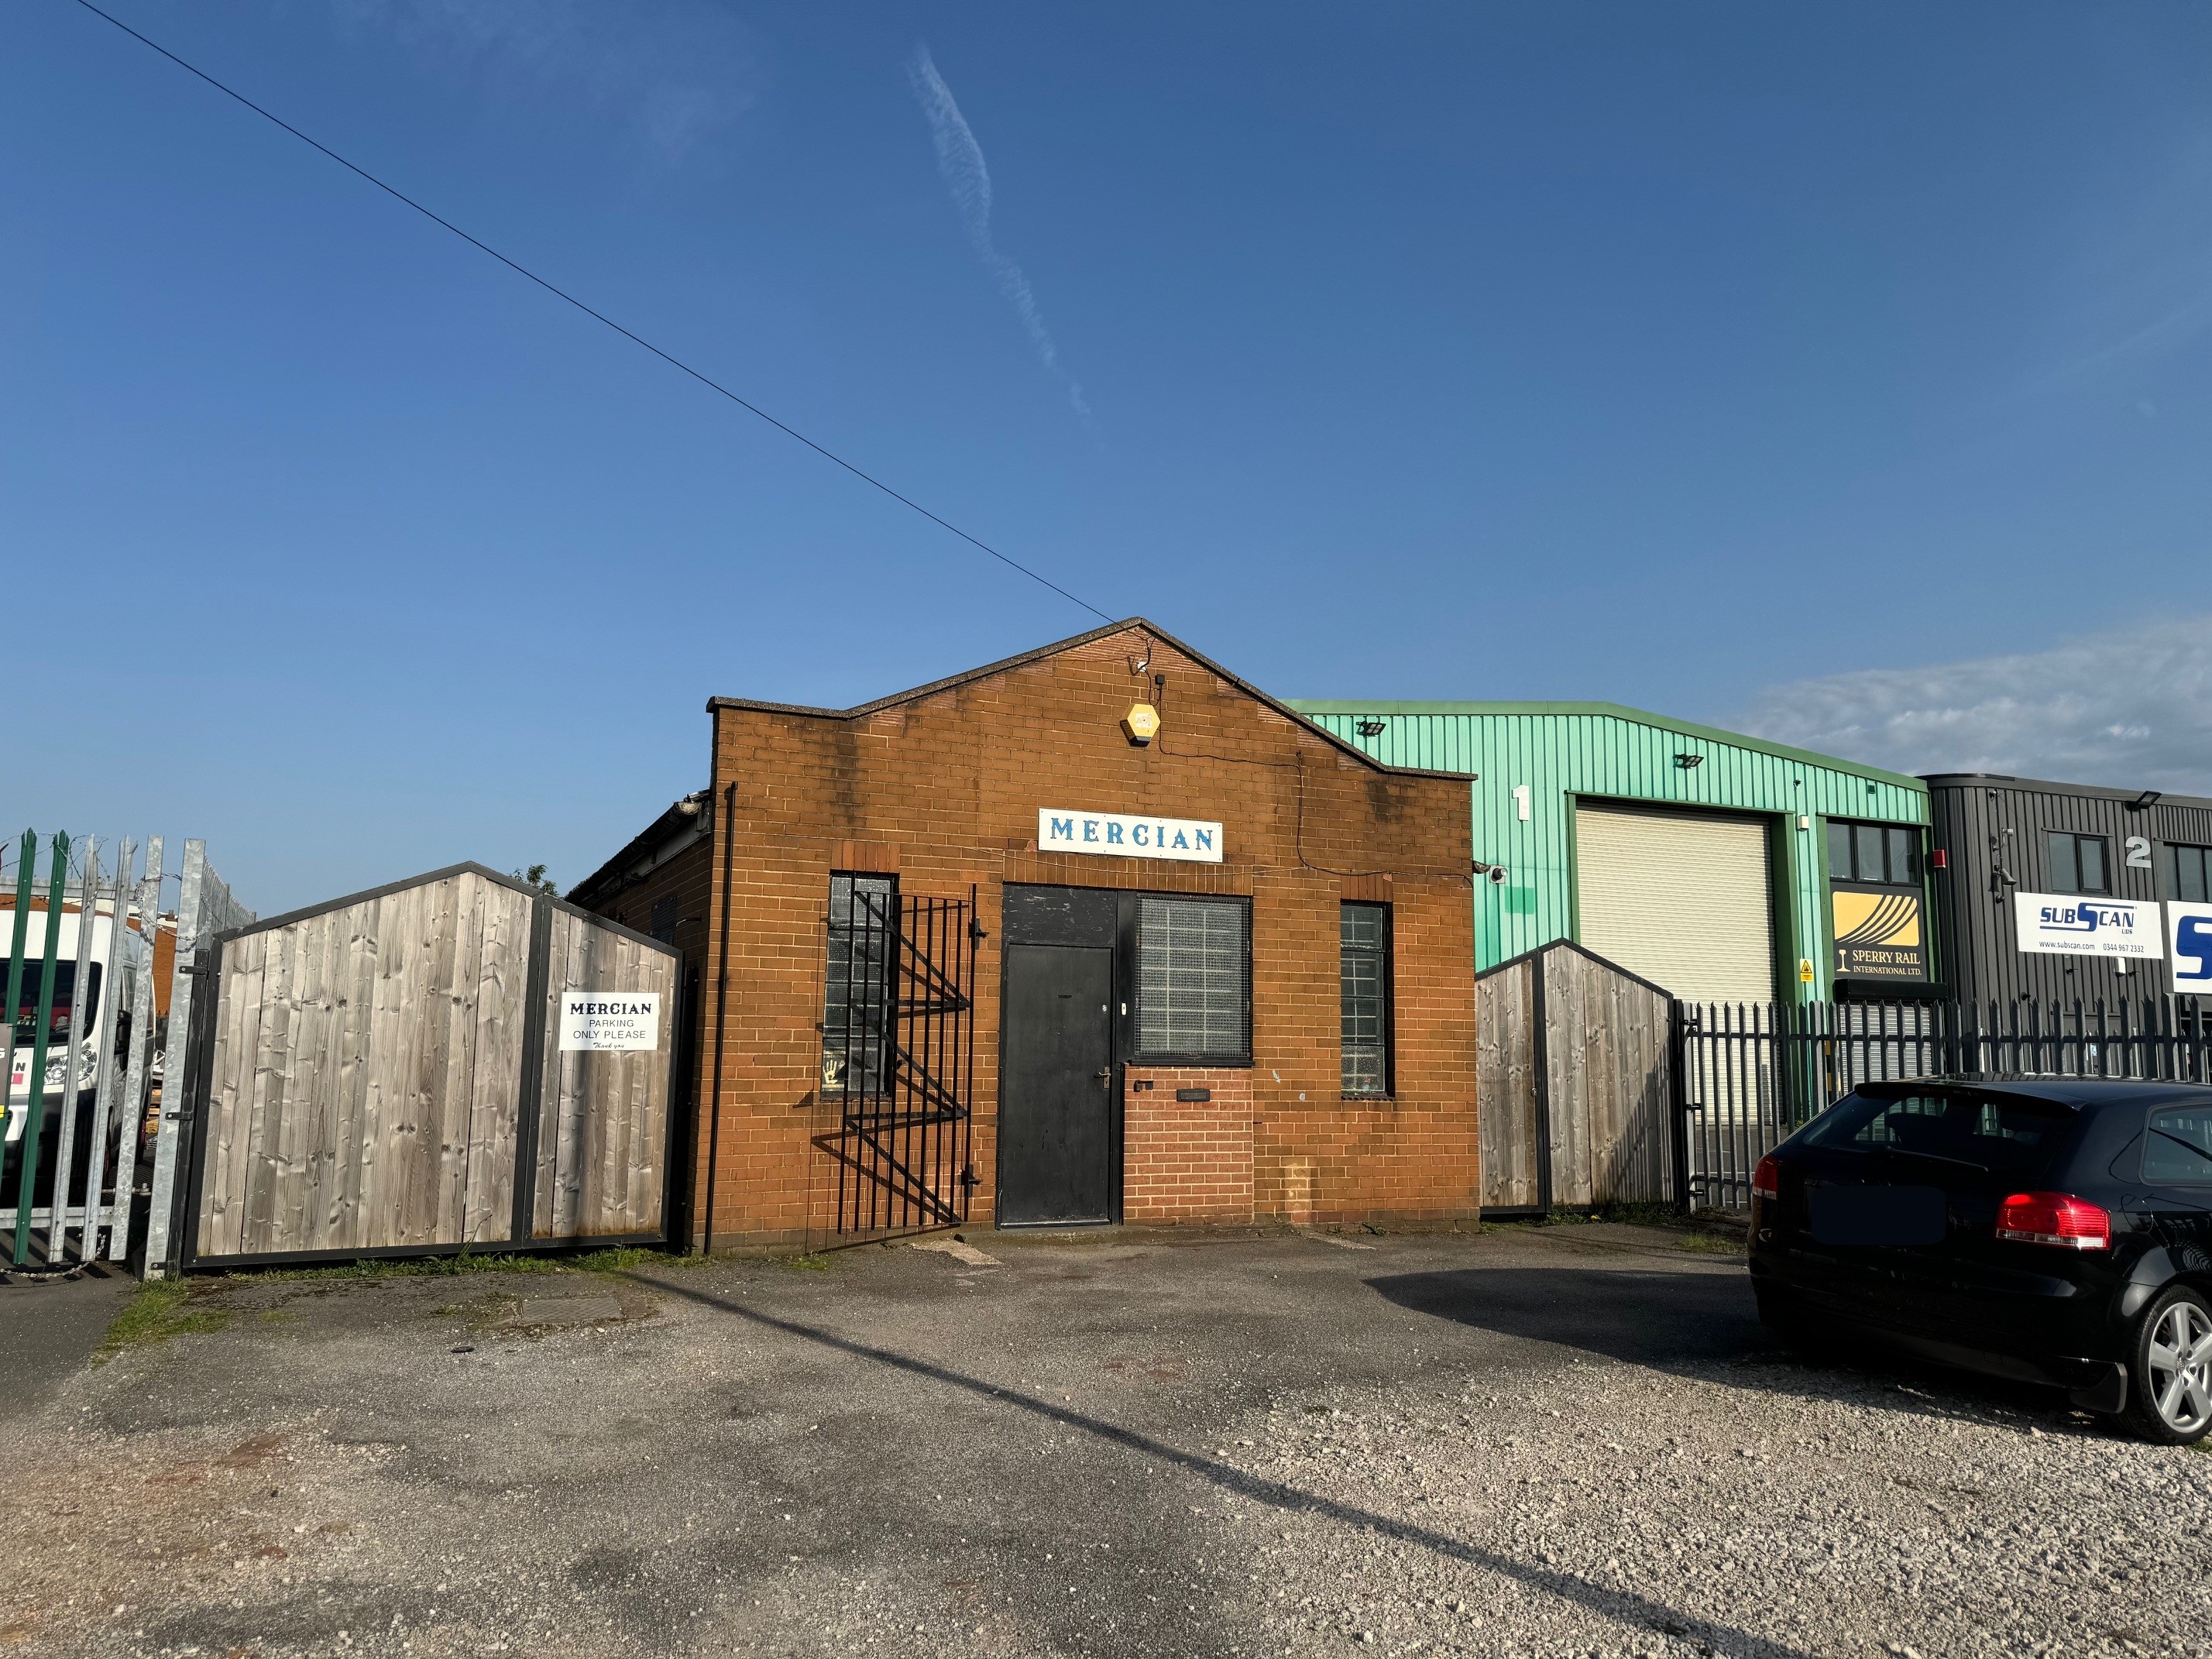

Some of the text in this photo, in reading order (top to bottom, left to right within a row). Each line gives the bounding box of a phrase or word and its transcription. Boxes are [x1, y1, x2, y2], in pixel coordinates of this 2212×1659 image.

[1511, 785, 1530, 821] 1
[1050, 817, 1213, 851] MERCIAN
[2124, 836, 2152, 869] 2
[2039, 902, 2135, 933] SUBSCAN
[2039, 940, 2095, 950] www.subscan.com
[2103, 943, 2118, 952] 0344
[2130, 944, 2145, 953] 2332
[1853, 950, 1921, 964] SPERRY RAIL
[1853, 965, 1907, 975] INTERNATIONAL
[570, 1003, 652, 1015] MERCIAN
[589, 1019, 634, 1028] PARKING
[573, 1030, 646, 1039] ONLY PLEASE
